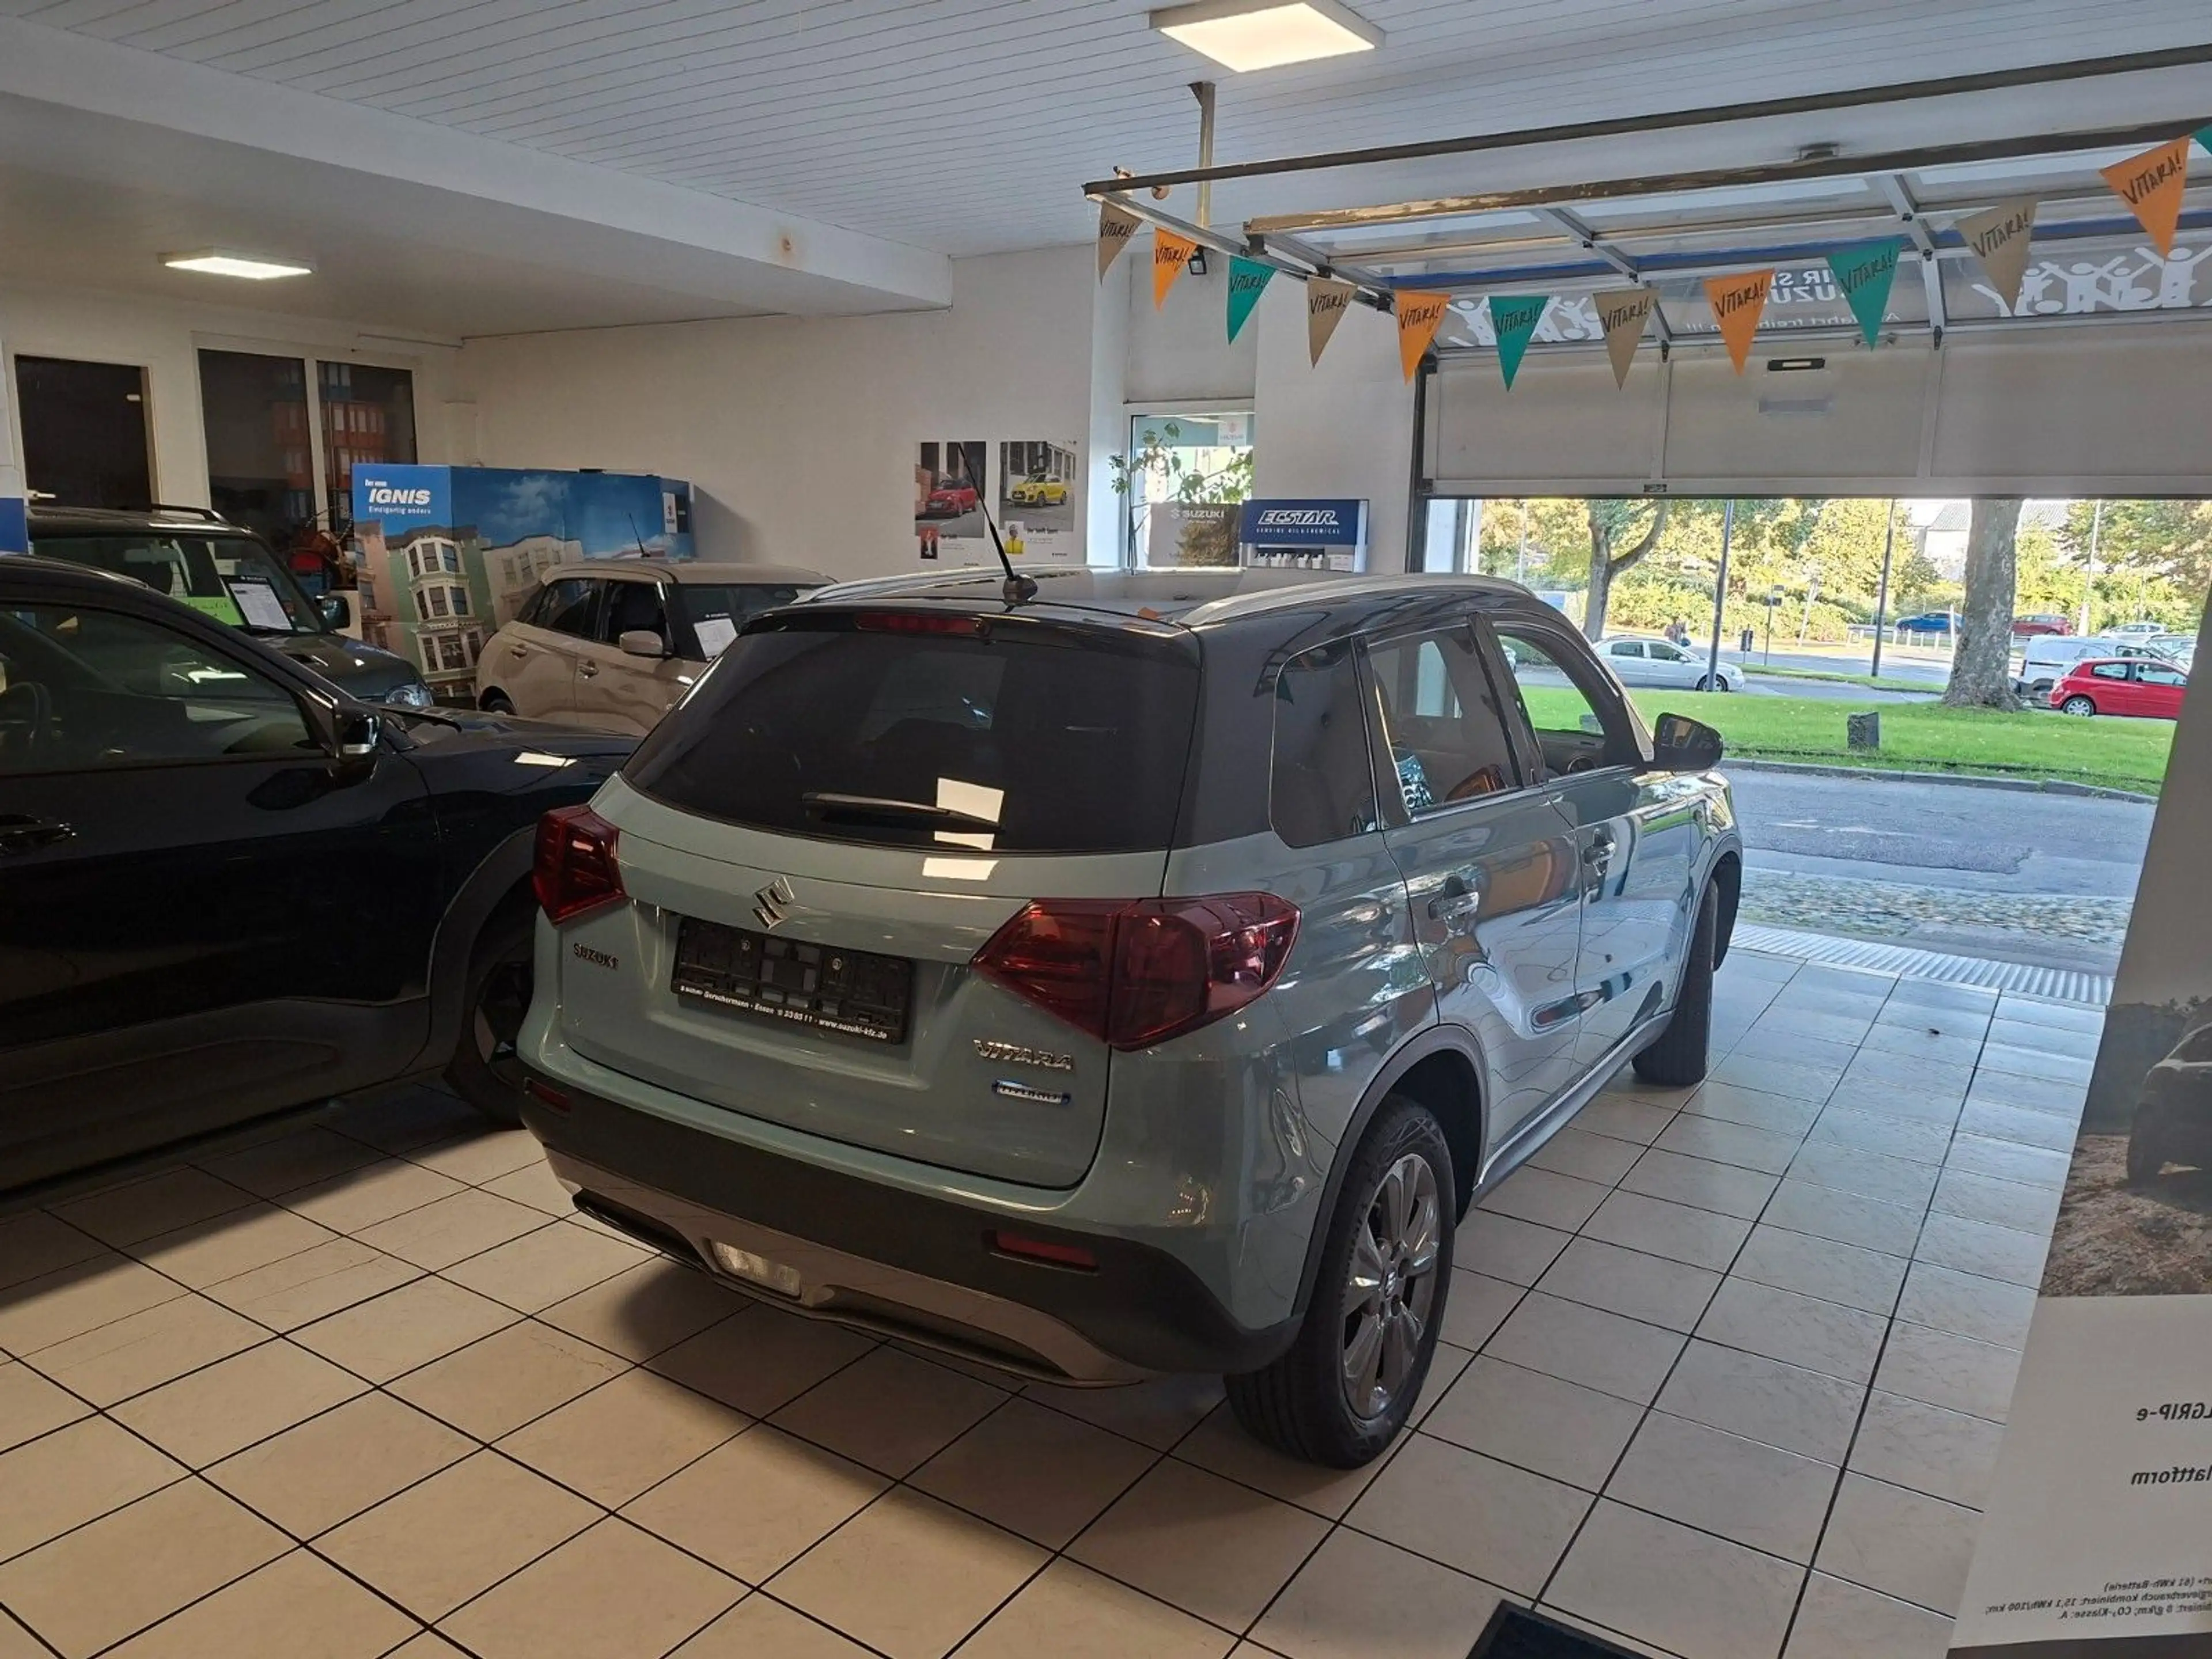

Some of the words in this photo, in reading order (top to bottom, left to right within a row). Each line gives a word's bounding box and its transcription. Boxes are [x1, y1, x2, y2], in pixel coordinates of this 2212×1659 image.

[2122, 149, 2183, 204] VITARA!
[1101, 219, 1134, 238] VITARA!
[1972, 208, 2029, 258] VITARA!
[1156, 246, 1187, 264] VITARA!
[1841, 251, 1892, 294] VITARA!
[1310, 291, 1349, 315] VITARA!
[1715, 278, 1764, 318] VITARA!
[1399, 303, 1441, 329] VITARA!
[1497, 306, 1540, 335] VITARA!
[1602, 296, 1649, 333] VITARA!
[369, 488, 431, 505] IGNIS
[1182, 509, 1225, 518] SUZUKI
[1258, 510, 1339, 525] ECSTAR
[574, 942, 619, 969] SUZUKI
[974, 1039, 1074, 1070] VITARA
